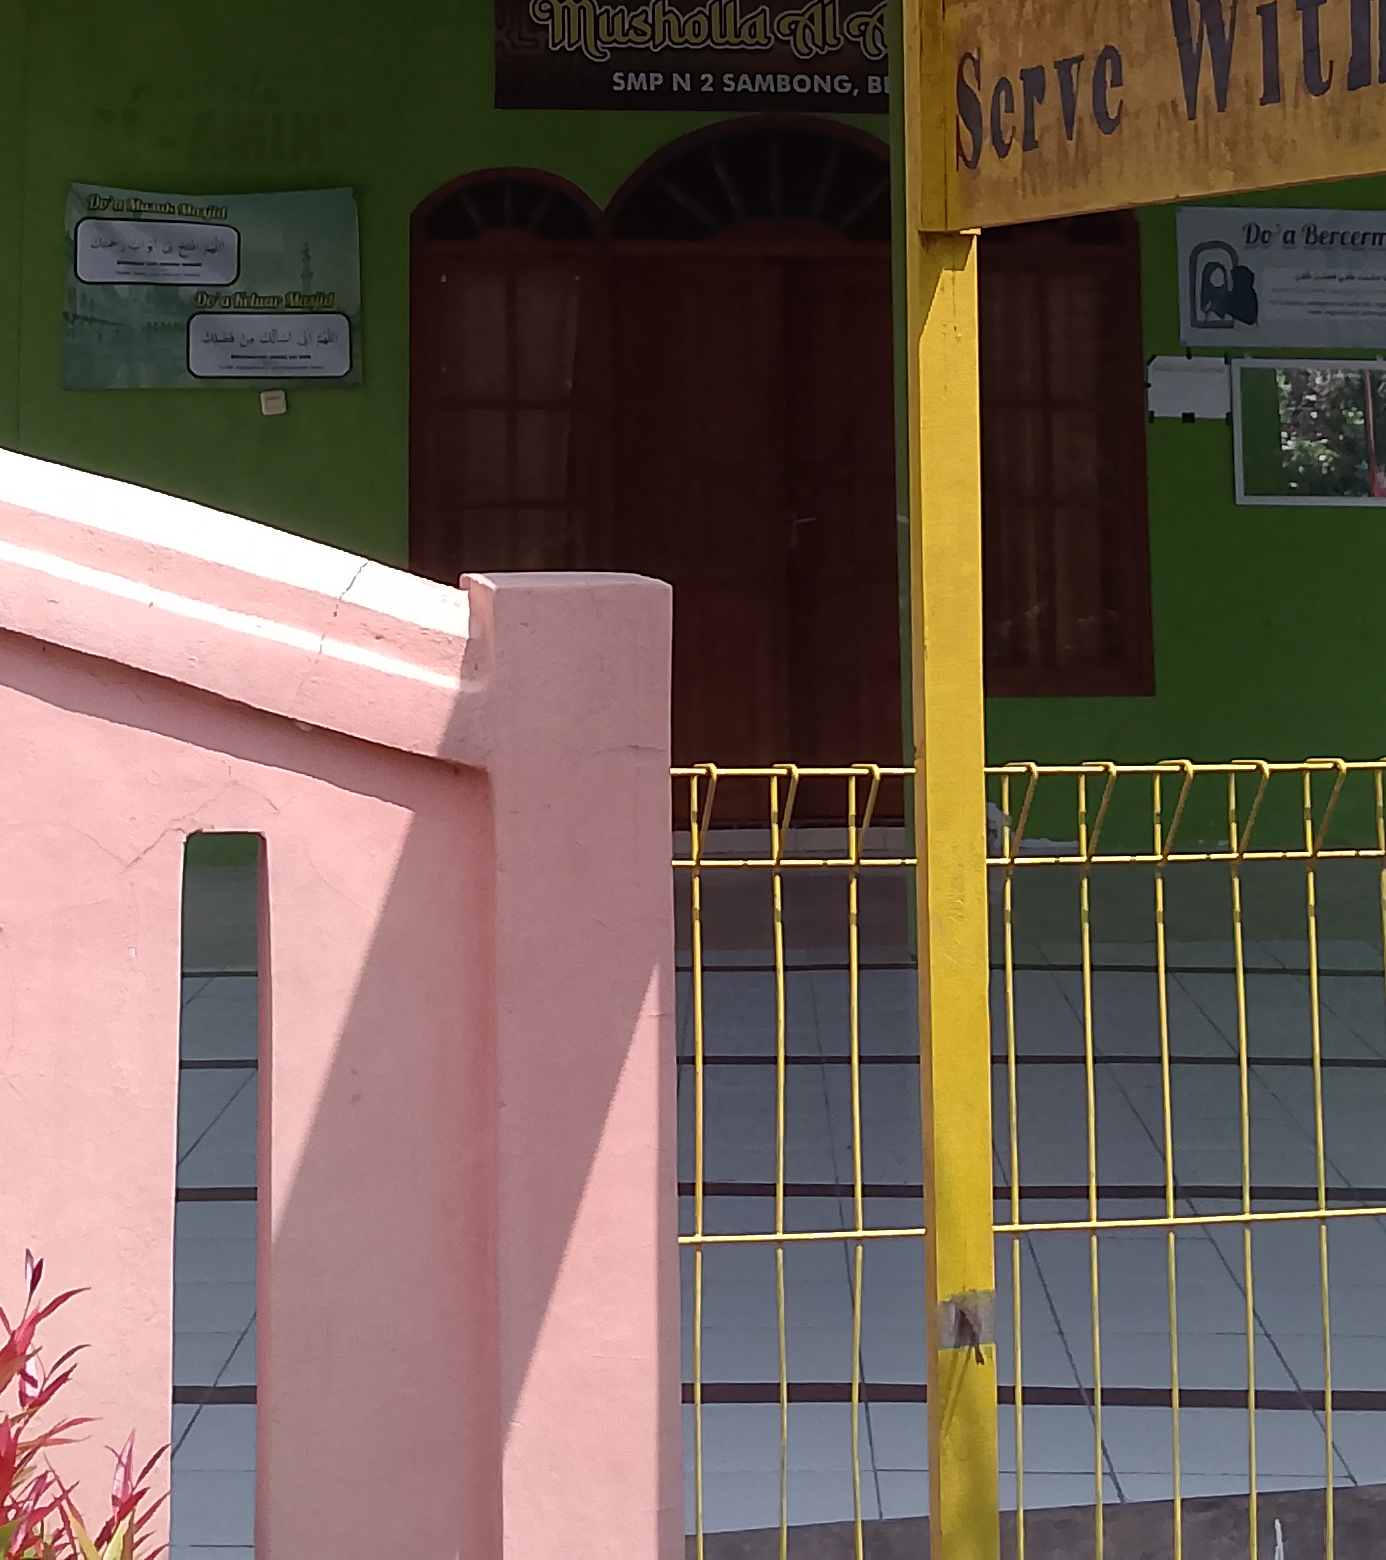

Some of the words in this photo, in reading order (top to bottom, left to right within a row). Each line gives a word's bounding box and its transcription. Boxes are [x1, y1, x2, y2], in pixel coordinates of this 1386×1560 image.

[612, 72, 663, 92] SMP
[672, 73, 691, 92] N
[700, 73, 714, 92] 2
[722, 73, 859, 96] SAMBONG,
